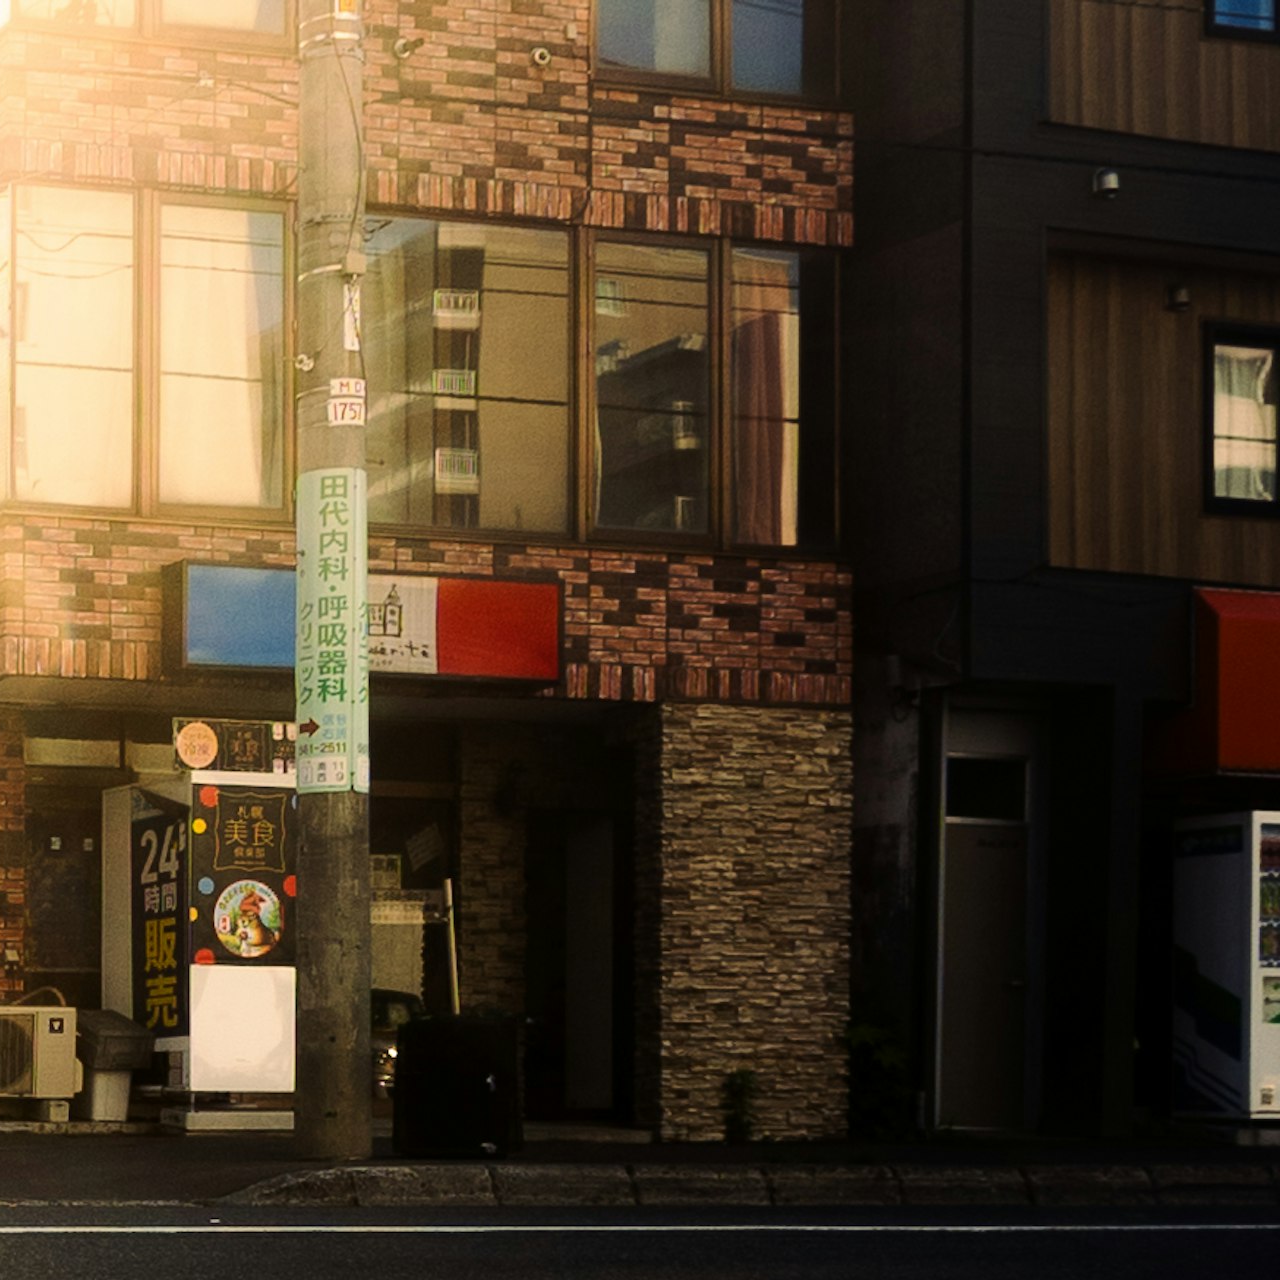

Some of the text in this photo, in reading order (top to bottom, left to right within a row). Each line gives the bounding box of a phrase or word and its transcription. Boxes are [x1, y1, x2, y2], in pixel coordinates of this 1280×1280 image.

[333, 402, 363, 421] 1757
[318, 475, 349, 703] 田代内科・呼吸器科
[300, 602, 314, 704] クリニック
[141, 823, 179, 884] 24
[144, 882, 178, 914] 時間
[145, 917, 178, 1029] 販売
